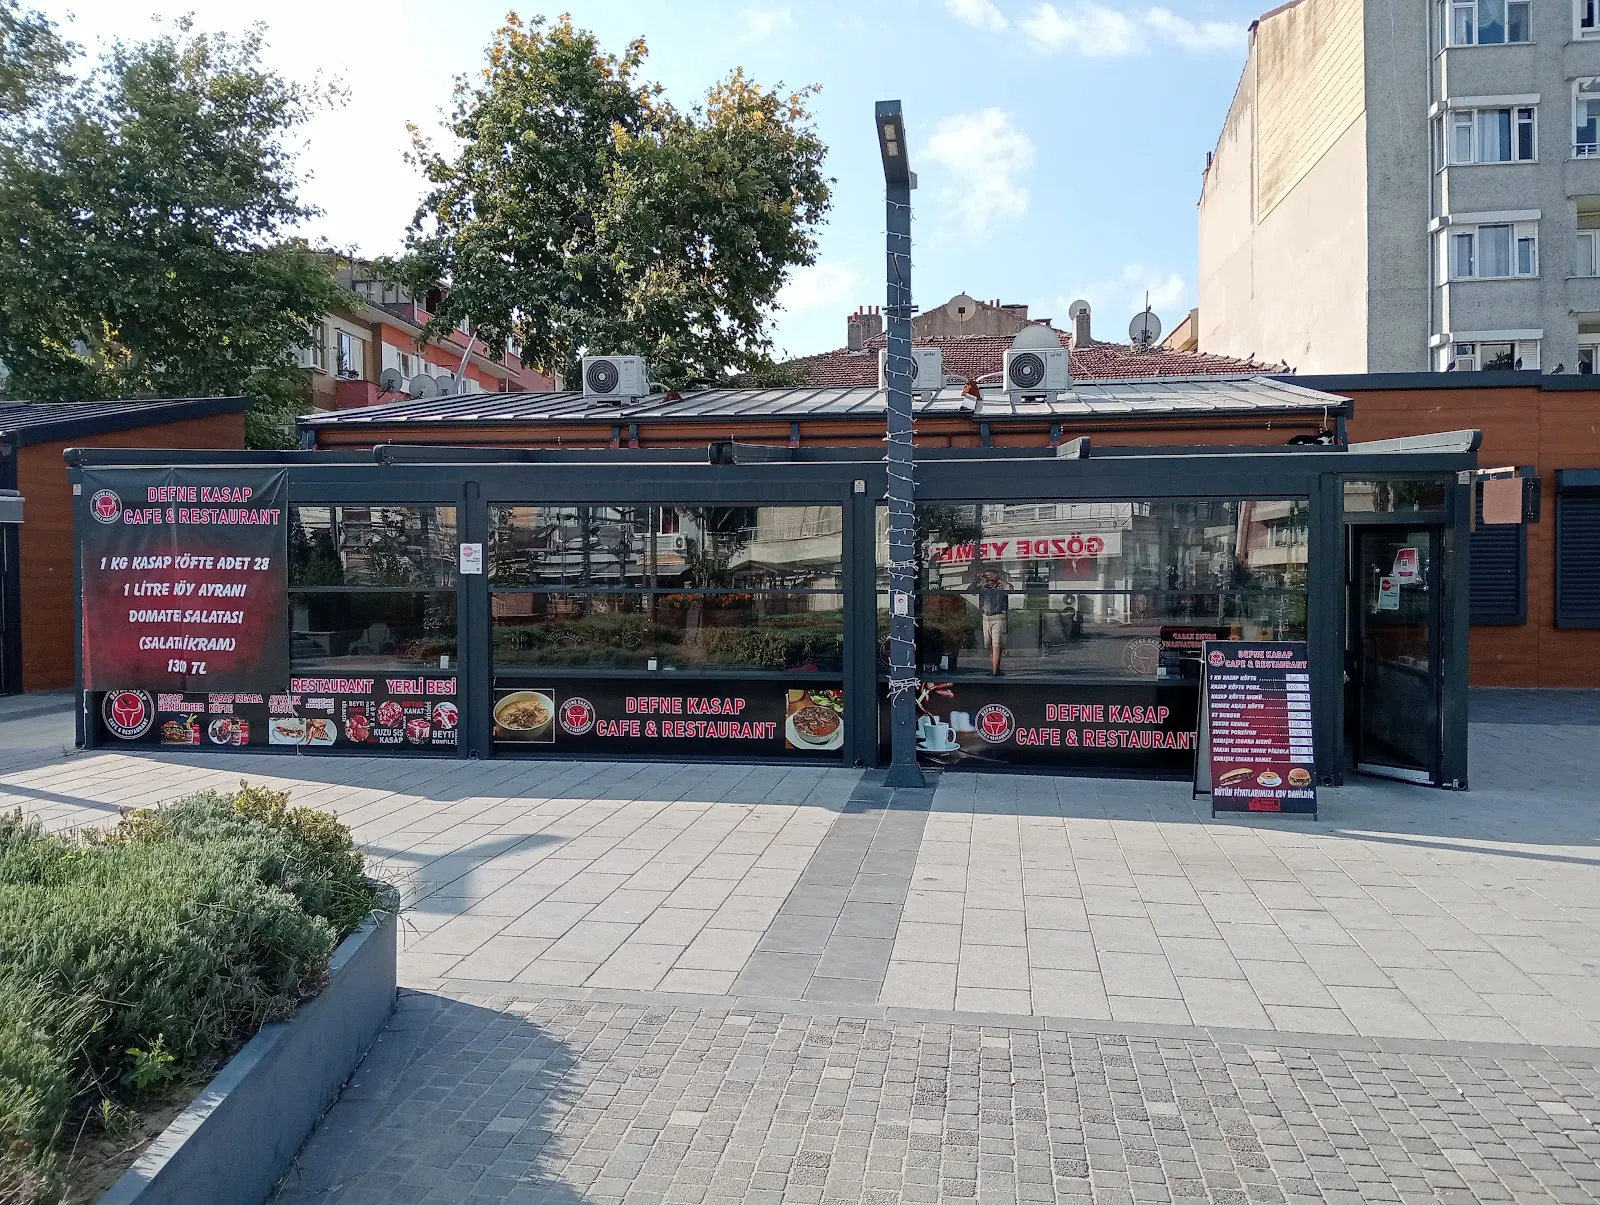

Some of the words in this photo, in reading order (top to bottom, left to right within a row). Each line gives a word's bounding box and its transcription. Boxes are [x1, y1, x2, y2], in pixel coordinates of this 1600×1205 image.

[148, 487, 197, 502] DEFNE
[201, 487, 253, 503] KASAP
[123, 508, 162, 524] CAFE
[165, 509, 175, 523] &
[179, 509, 280, 525] RESTAURANT
[100, 557, 107, 569] 1
[111, 557, 128, 571] KG
[132, 556, 172, 570] KASAP
[217, 557, 251, 570] ADET
[254, 558, 270, 570] 28
[123, 584, 130, 596] 1
[134, 580, 170, 596] LİTRE
[198, 584, 247, 597] AYRANI
[183, 610, 244, 624] SALATASI
[1266, 650, 1293, 659] KASAP
[191, 661, 207, 675] TL
[1255, 660, 1307, 669] RESTAURANT
[290, 678, 374, 694] RESTAURANT
[386, 677, 423, 694] YERLİ
[426, 677, 457, 695] BESİ
[158, 693, 184, 702] KASAP
[208, 693, 235, 703] KASAP
[158, 703, 205, 712] HAMBURGER
[625, 697, 683, 714] DEFNE
[687, 697, 746, 715] KASAP
[1045, 703, 1104, 722] DEFNE
[1108, 704, 1169, 724] KASAP
[597, 720, 641, 737] CAFE
[644, 721, 658, 737] &
[662, 721, 776, 739] RESTAURANT
[1016, 728, 1061, 747] CAFE
[1065, 729, 1079, 747] &
[1083, 730, 1198, 750] RESTAURANT
[1214, 787, 1233, 797] BÜTÜN
[1234, 786, 1274, 798] FİYATLARIMIZA
[1275, 789, 1287, 798] KDV
[1288, 788, 1314, 799] DAHİLDİR
